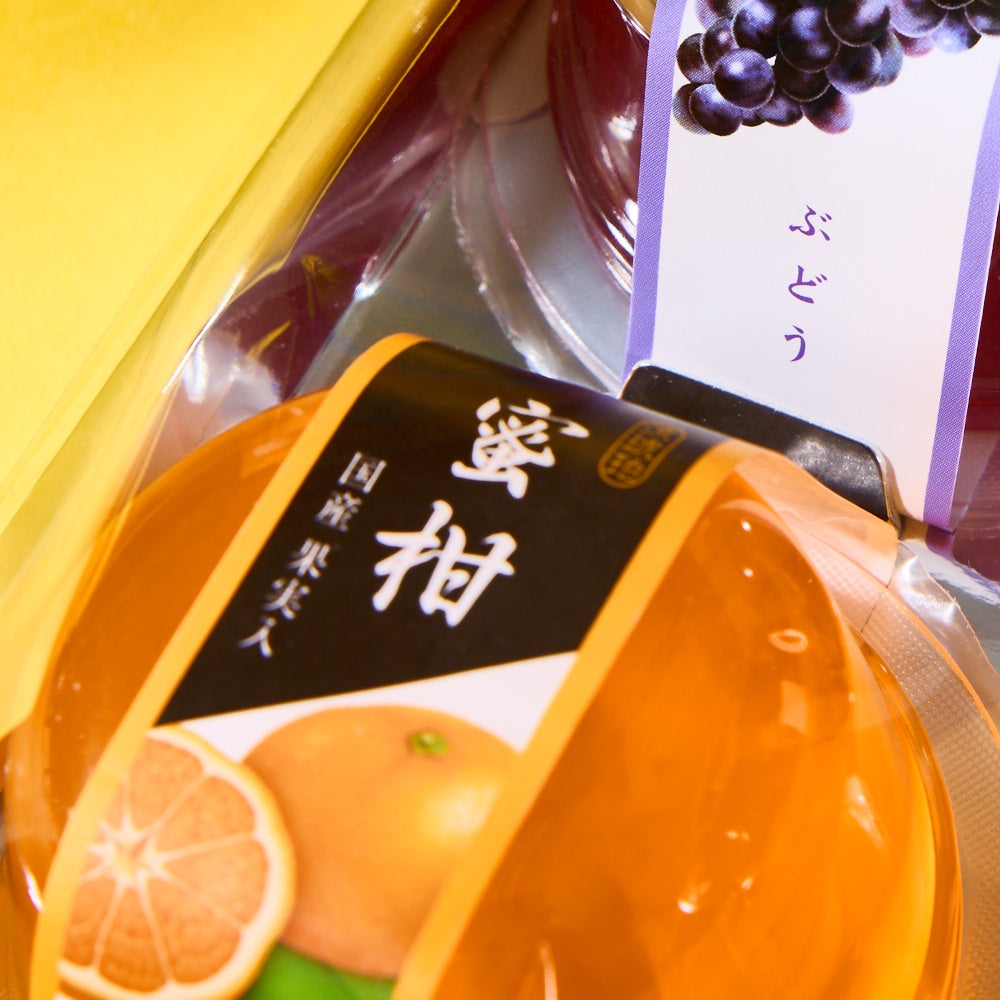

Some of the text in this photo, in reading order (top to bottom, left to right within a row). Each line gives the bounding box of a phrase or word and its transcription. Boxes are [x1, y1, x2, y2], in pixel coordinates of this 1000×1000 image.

[784, 205, 833, 363] ぶどう
[373, 397, 590, 628] 蜜柑
